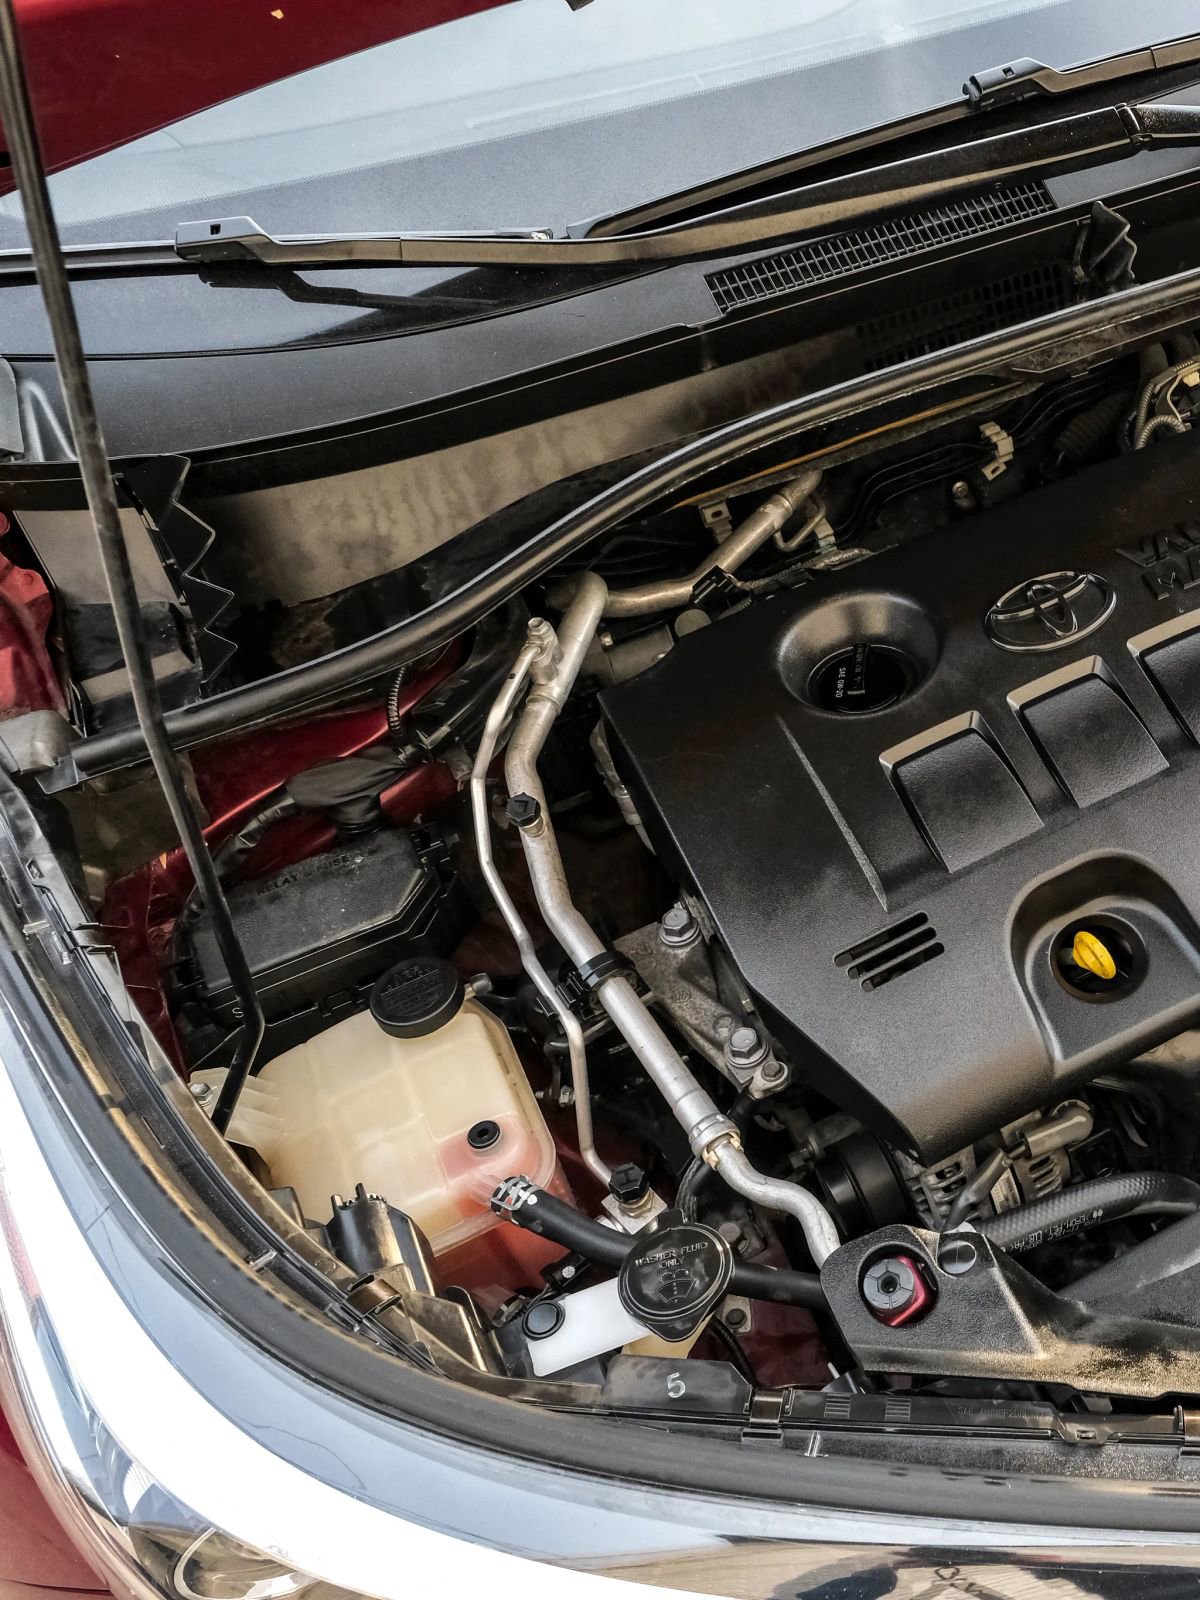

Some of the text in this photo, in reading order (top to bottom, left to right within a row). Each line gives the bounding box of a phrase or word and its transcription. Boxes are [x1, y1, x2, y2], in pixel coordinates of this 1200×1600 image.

[634, 1242, 709, 1267] WASHER FLUID
[659, 1257, 685, 1269] ONLY
[666, 1371, 686, 1398] 5
